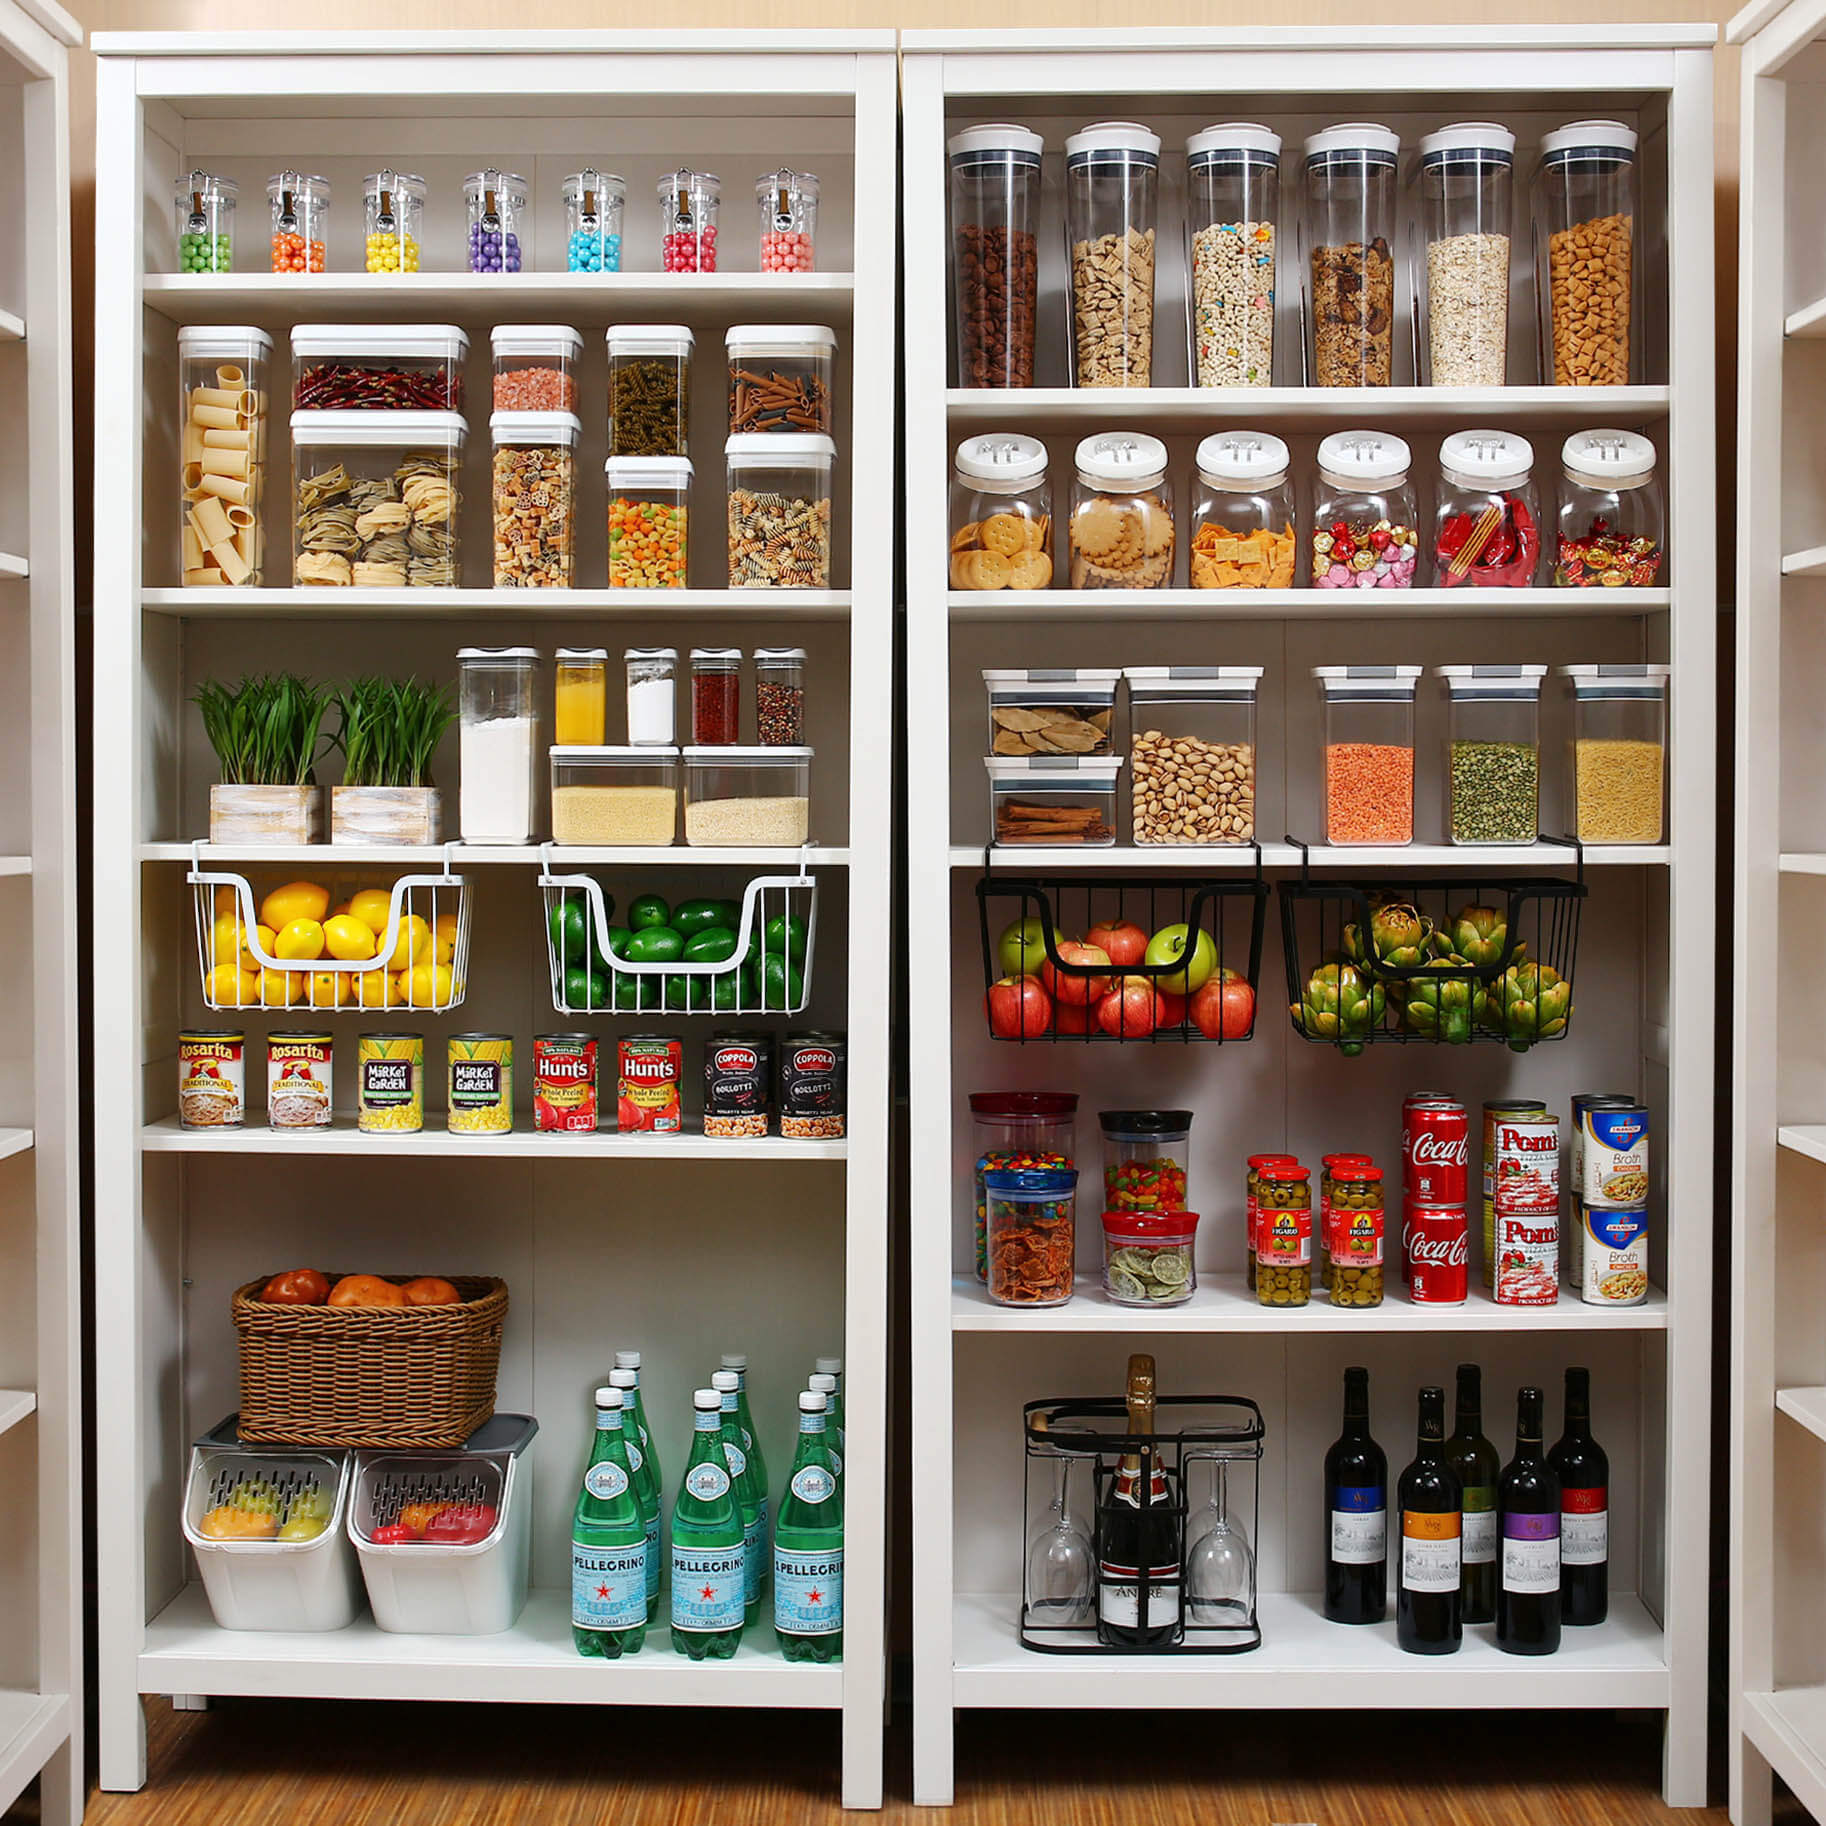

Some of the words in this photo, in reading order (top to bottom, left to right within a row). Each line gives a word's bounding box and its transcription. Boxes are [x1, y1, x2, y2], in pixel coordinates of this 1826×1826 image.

[181, 1043, 233, 1059] Rosarita
[271, 1044, 323, 1060] Rosarita
[718, 1053, 754, 1064] COPPOLA
[796, 1054, 833, 1065] COPPOLA
[538, 1058, 587, 1078] Hunt's
[624, 1058, 673, 1078] Hunt's
[184, 1079, 228, 1088] TRADITIONAL
[273, 1080, 319, 1089] TRADITIONAL
[1612, 1153, 1641, 1165] Broth
[1608, 1251, 1639, 1263] Broth
